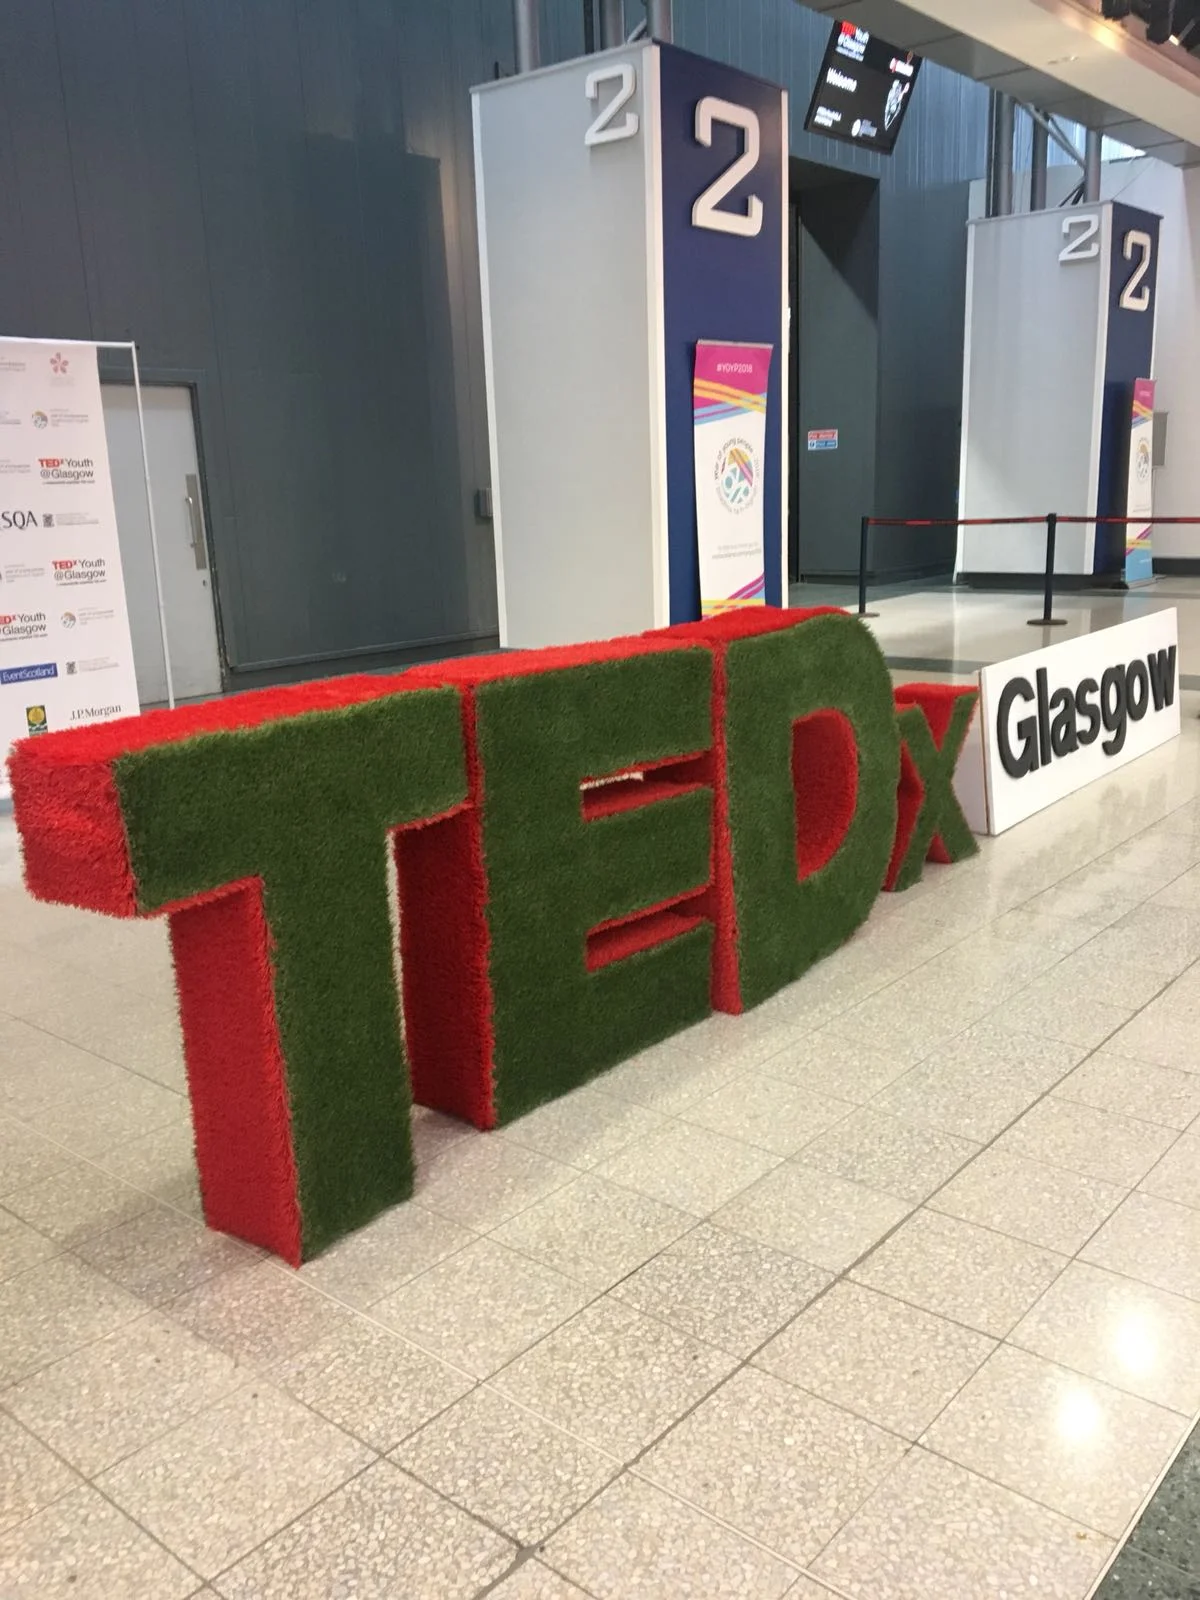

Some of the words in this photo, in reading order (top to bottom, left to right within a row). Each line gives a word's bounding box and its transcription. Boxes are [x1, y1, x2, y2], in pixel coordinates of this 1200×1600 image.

[585, 63, 639, 146] 2
[692, 96, 763, 237] 2
[1058, 214, 1100, 262] 2
[1119, 230, 1152, 312] 2
[40, 468, 94, 480] @Glasgow
[1, 510, 38, 530] SQA
[54, 570, 106, 581] @Glasgow
[0, 624, 47, 636] Glasgow
[8, 606, 978, 1267] TEDx
[997, 645, 1177, 779] Glasgow
